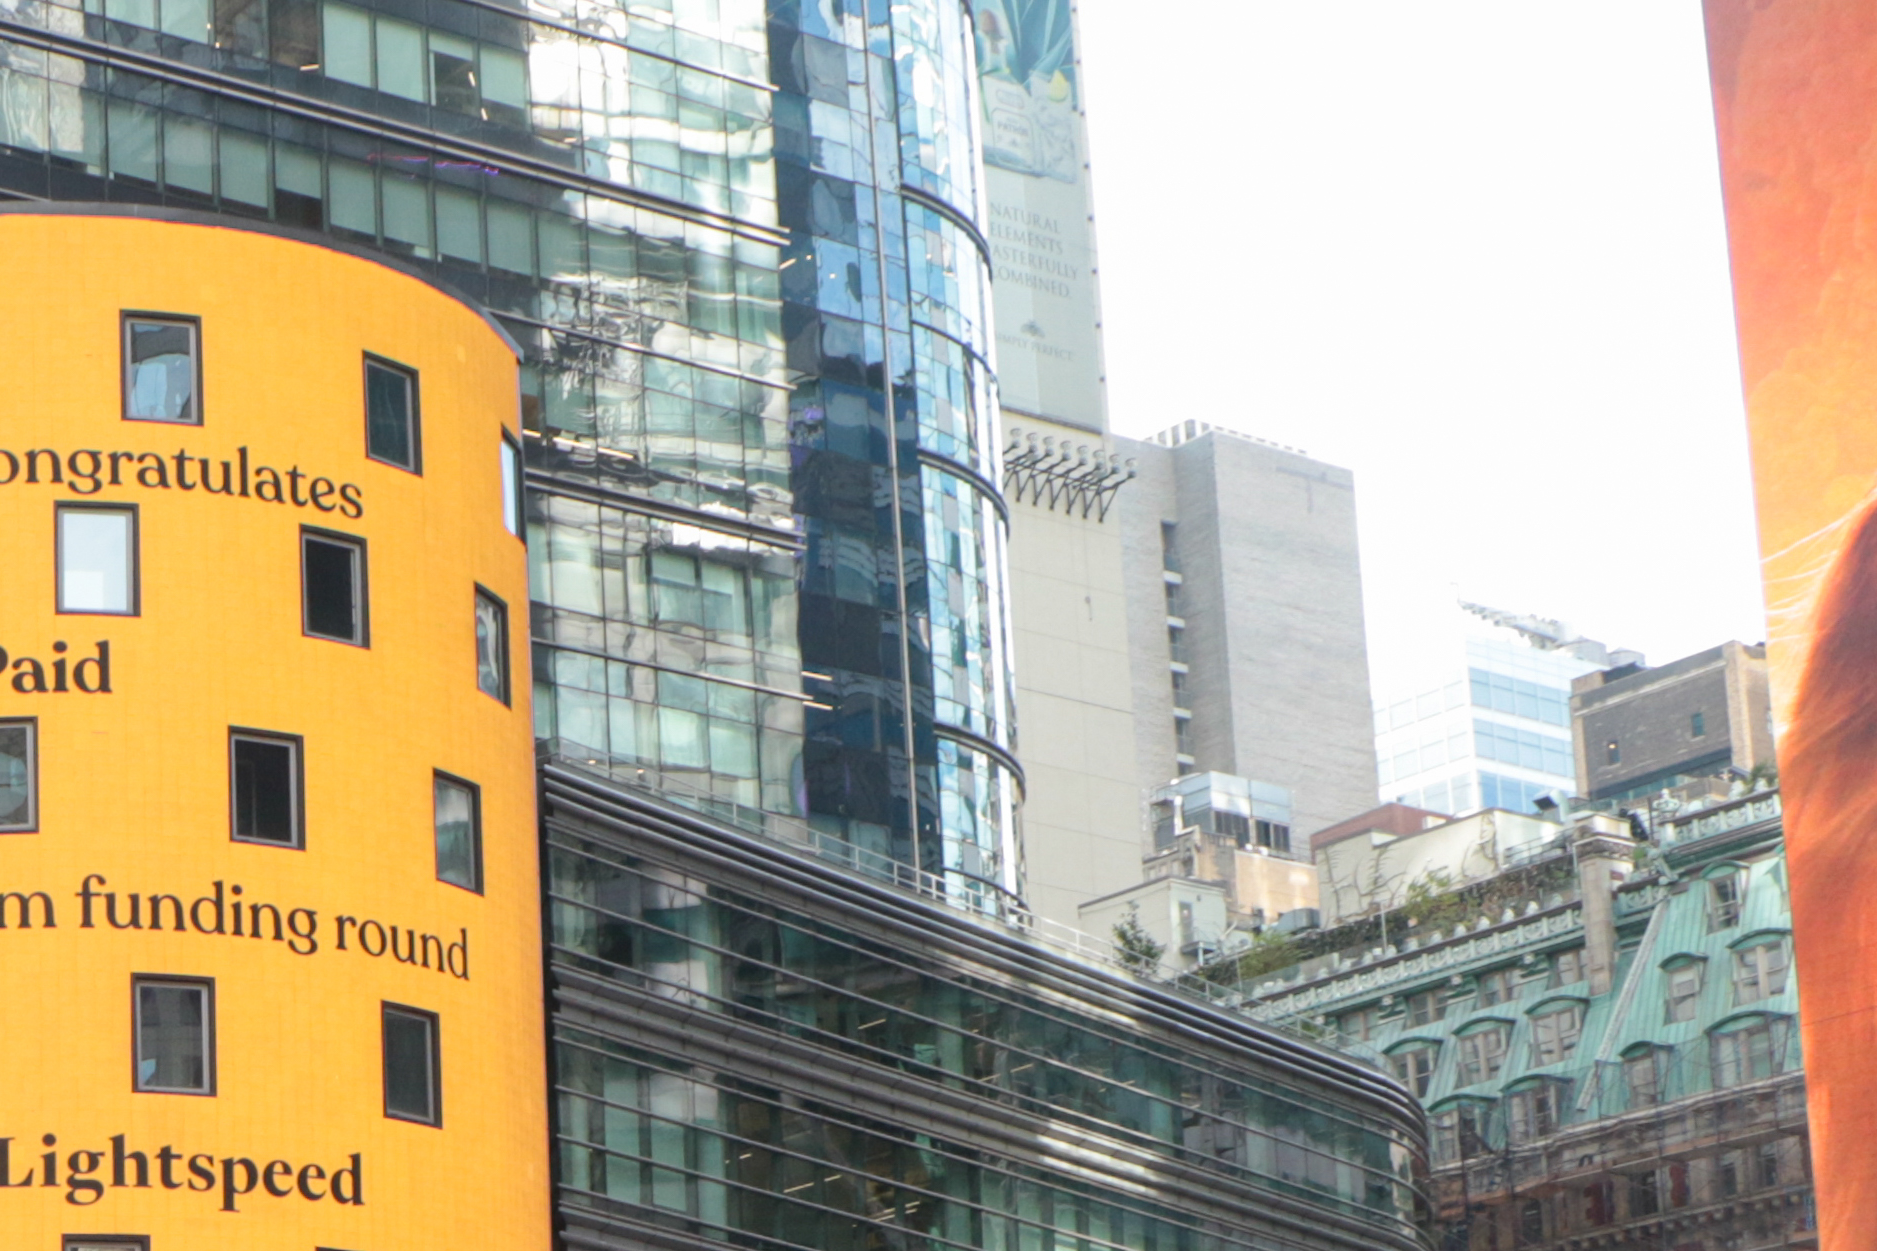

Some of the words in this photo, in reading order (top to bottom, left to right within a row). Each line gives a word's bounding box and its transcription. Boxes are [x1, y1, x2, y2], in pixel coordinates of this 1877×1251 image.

[990, 201, 1061, 235] NATURAL
[990, 221, 1064, 255] ELEMENTS
[992, 244, 1079, 281] ASTERFULLY
[75, 874, 318, 956] funding
[335, 915, 470, 981] round
